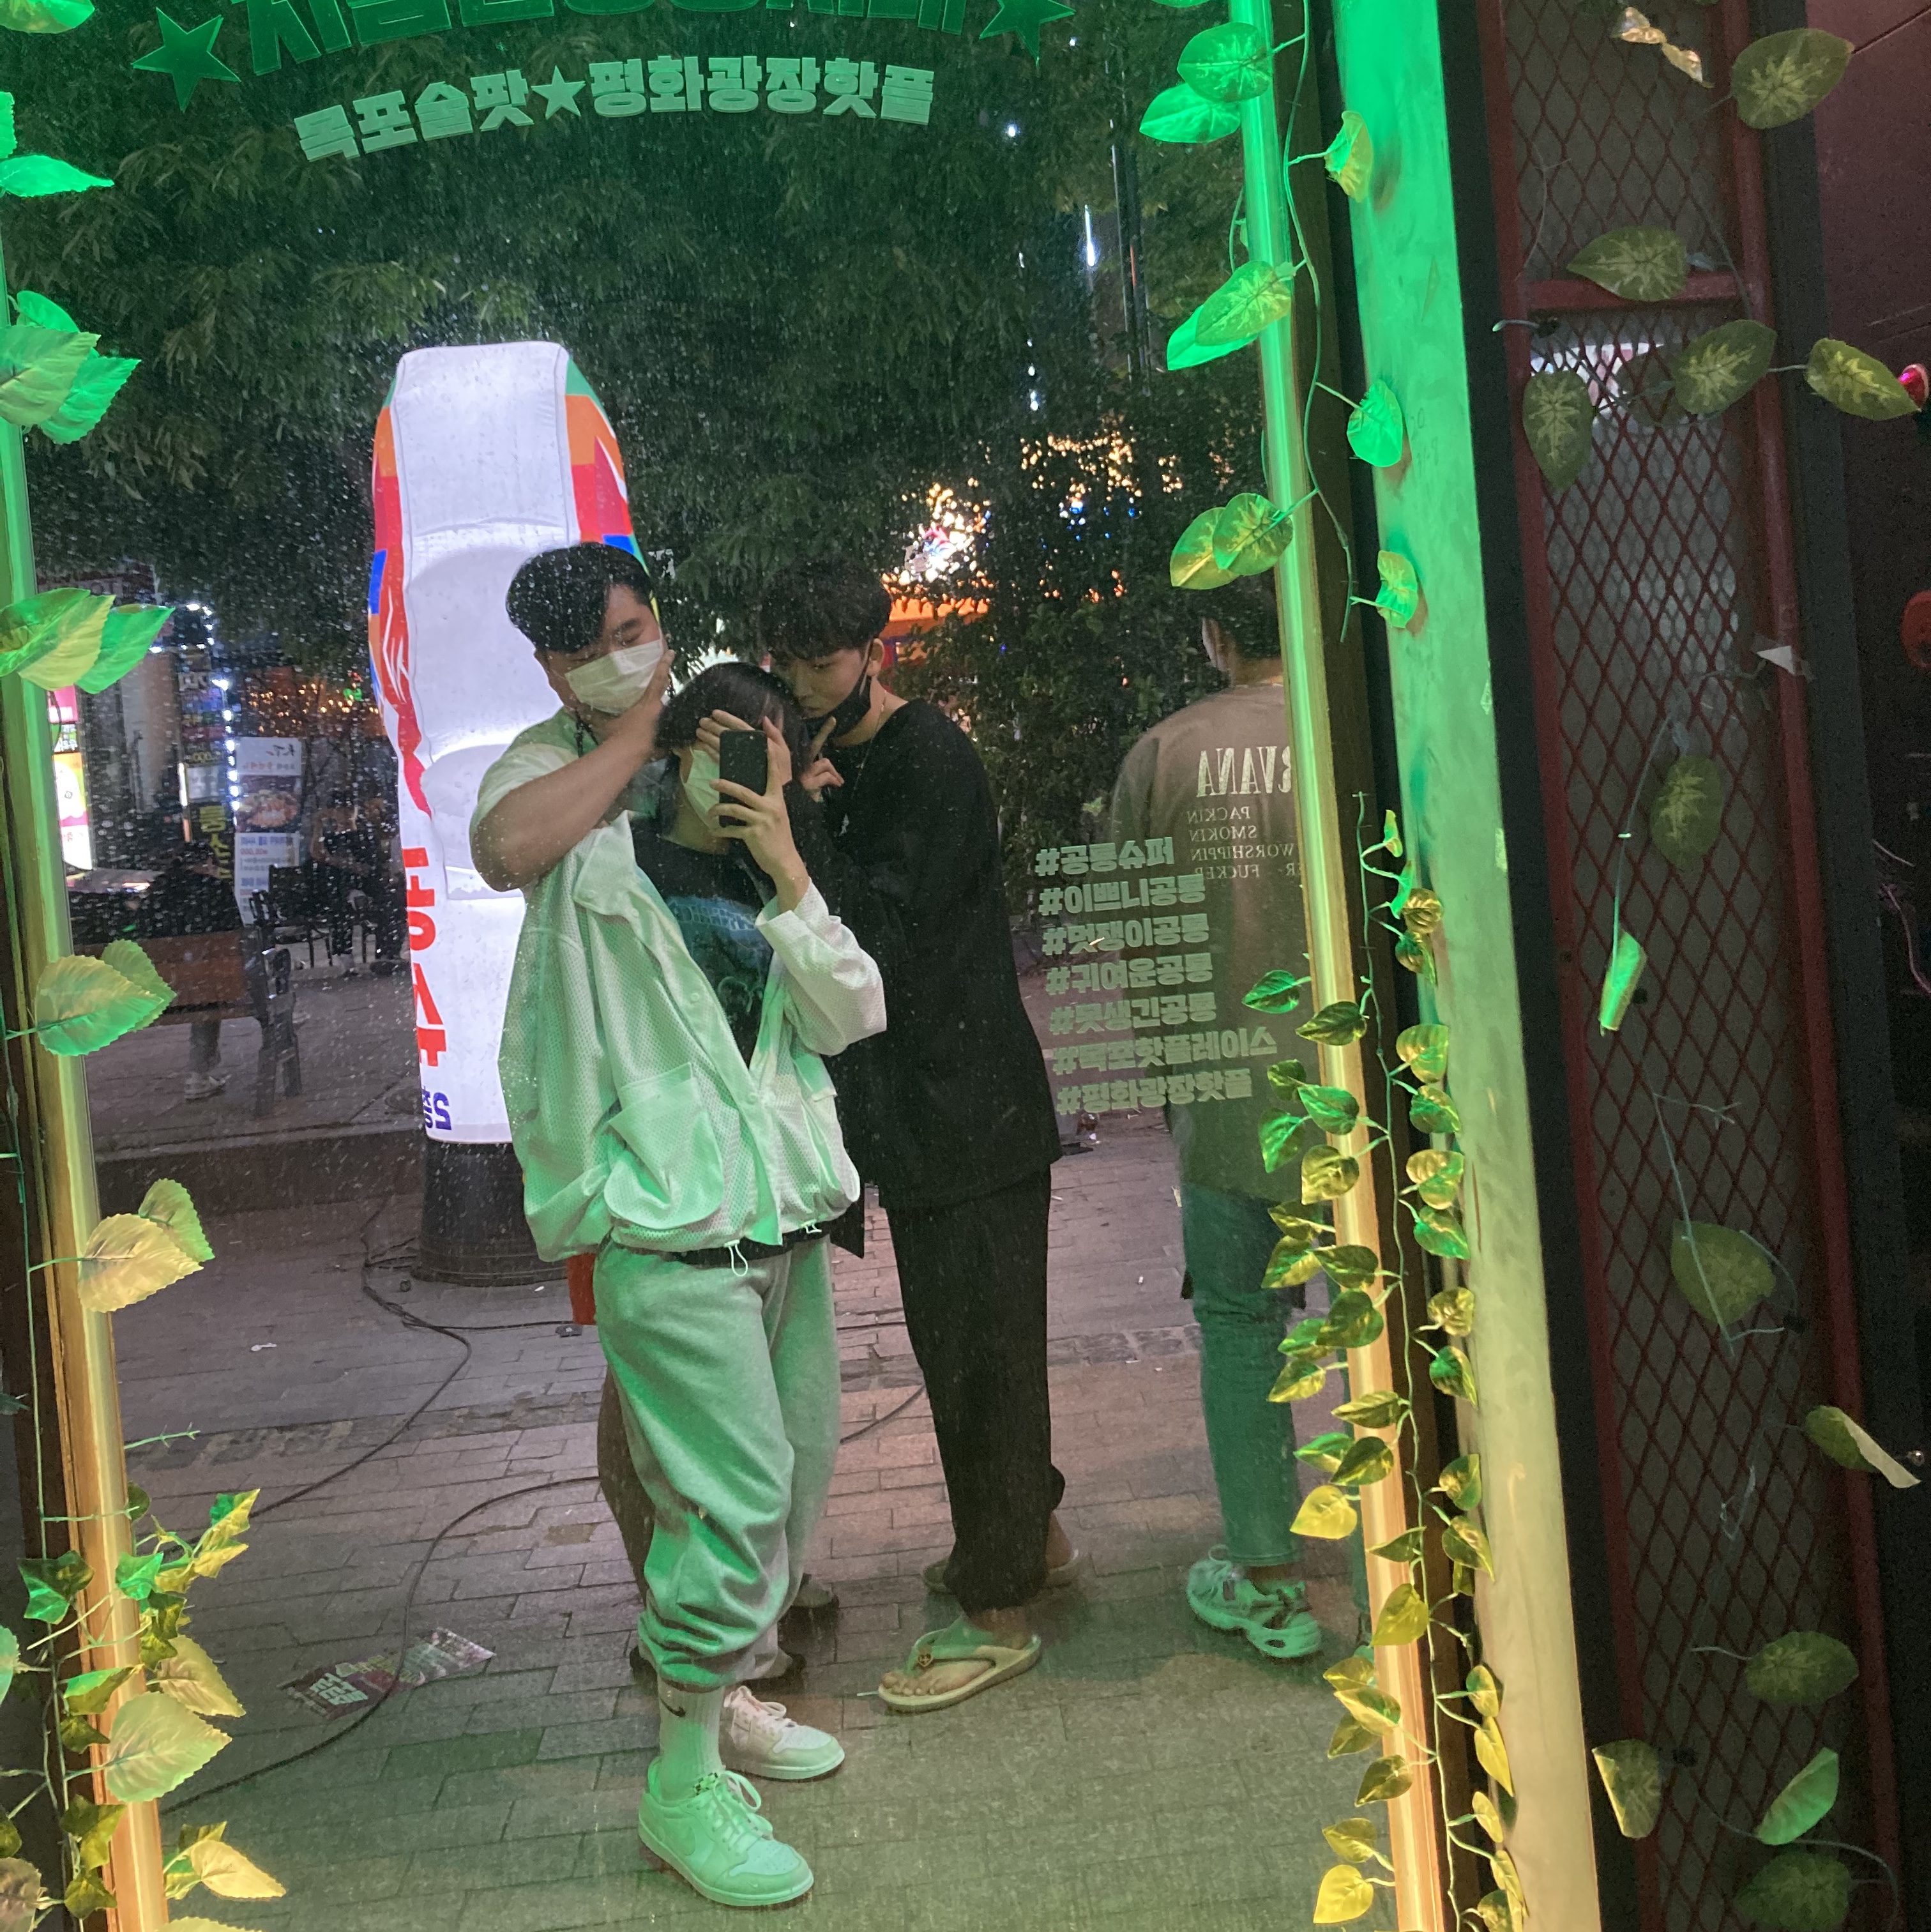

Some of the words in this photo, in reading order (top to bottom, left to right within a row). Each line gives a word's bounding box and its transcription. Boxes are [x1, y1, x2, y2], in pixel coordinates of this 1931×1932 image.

[588, 56, 935, 125] 평화광장핫플
[1034, 837, 1175, 877] #공룡슈퍼
[1038, 873, 1206, 916] #이쁘니공룡
[1041, 913, 1210, 955] #멋쟁이공룡
[1045, 952, 1213, 996] #귀여운공룡
[1049, 991, 1217, 1035] #못생긴공룡
[1052, 1026, 1278, 1076] #목포핫플레이스
[1056, 1068, 1253, 1116] #평화광장핫플
